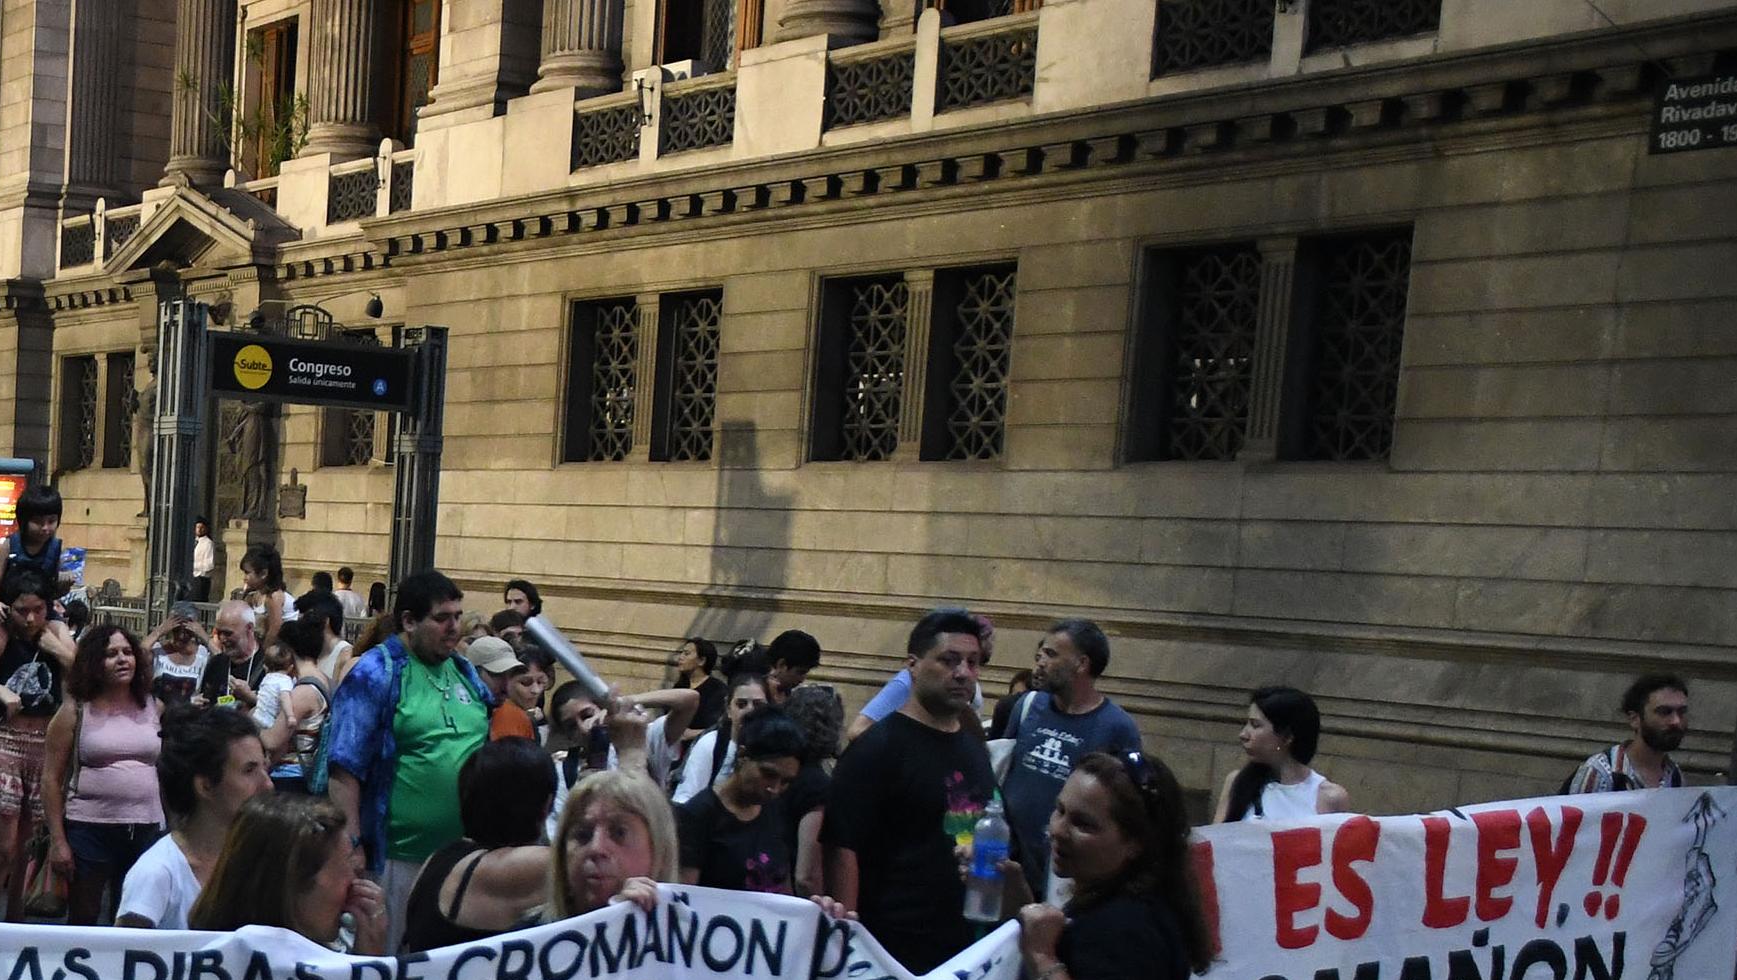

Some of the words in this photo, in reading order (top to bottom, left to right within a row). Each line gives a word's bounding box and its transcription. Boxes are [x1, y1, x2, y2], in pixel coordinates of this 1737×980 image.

[1658, 129, 1701, 149] 1800
[289, 358, 352, 377] Congreso
[288, 375, 312, 386] Salida
[1270, 814, 1381, 950] ES
[1421, 805, 1647, 930] LEY!!
